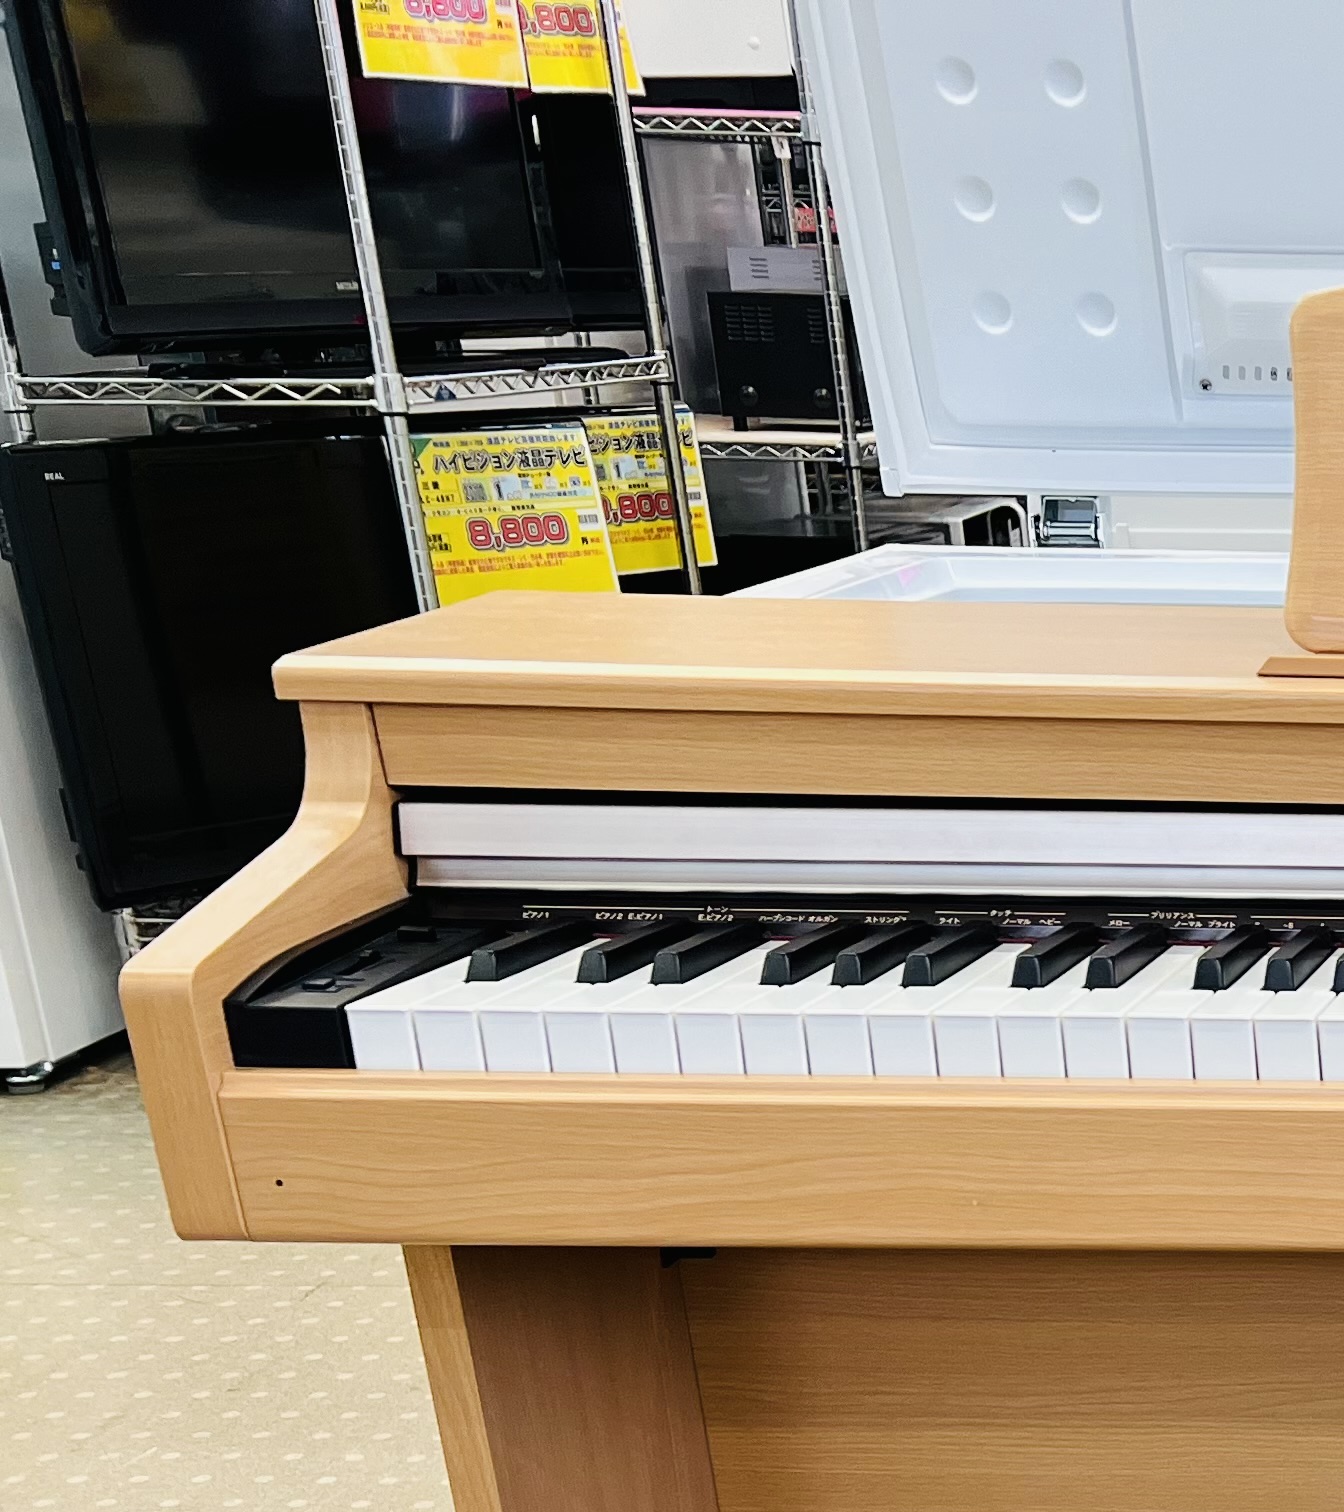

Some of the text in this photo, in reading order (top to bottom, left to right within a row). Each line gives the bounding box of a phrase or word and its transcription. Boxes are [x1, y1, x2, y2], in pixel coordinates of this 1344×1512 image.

[467, 512, 571, 551] 8,800
[706, 905, 729, 913] トーン
